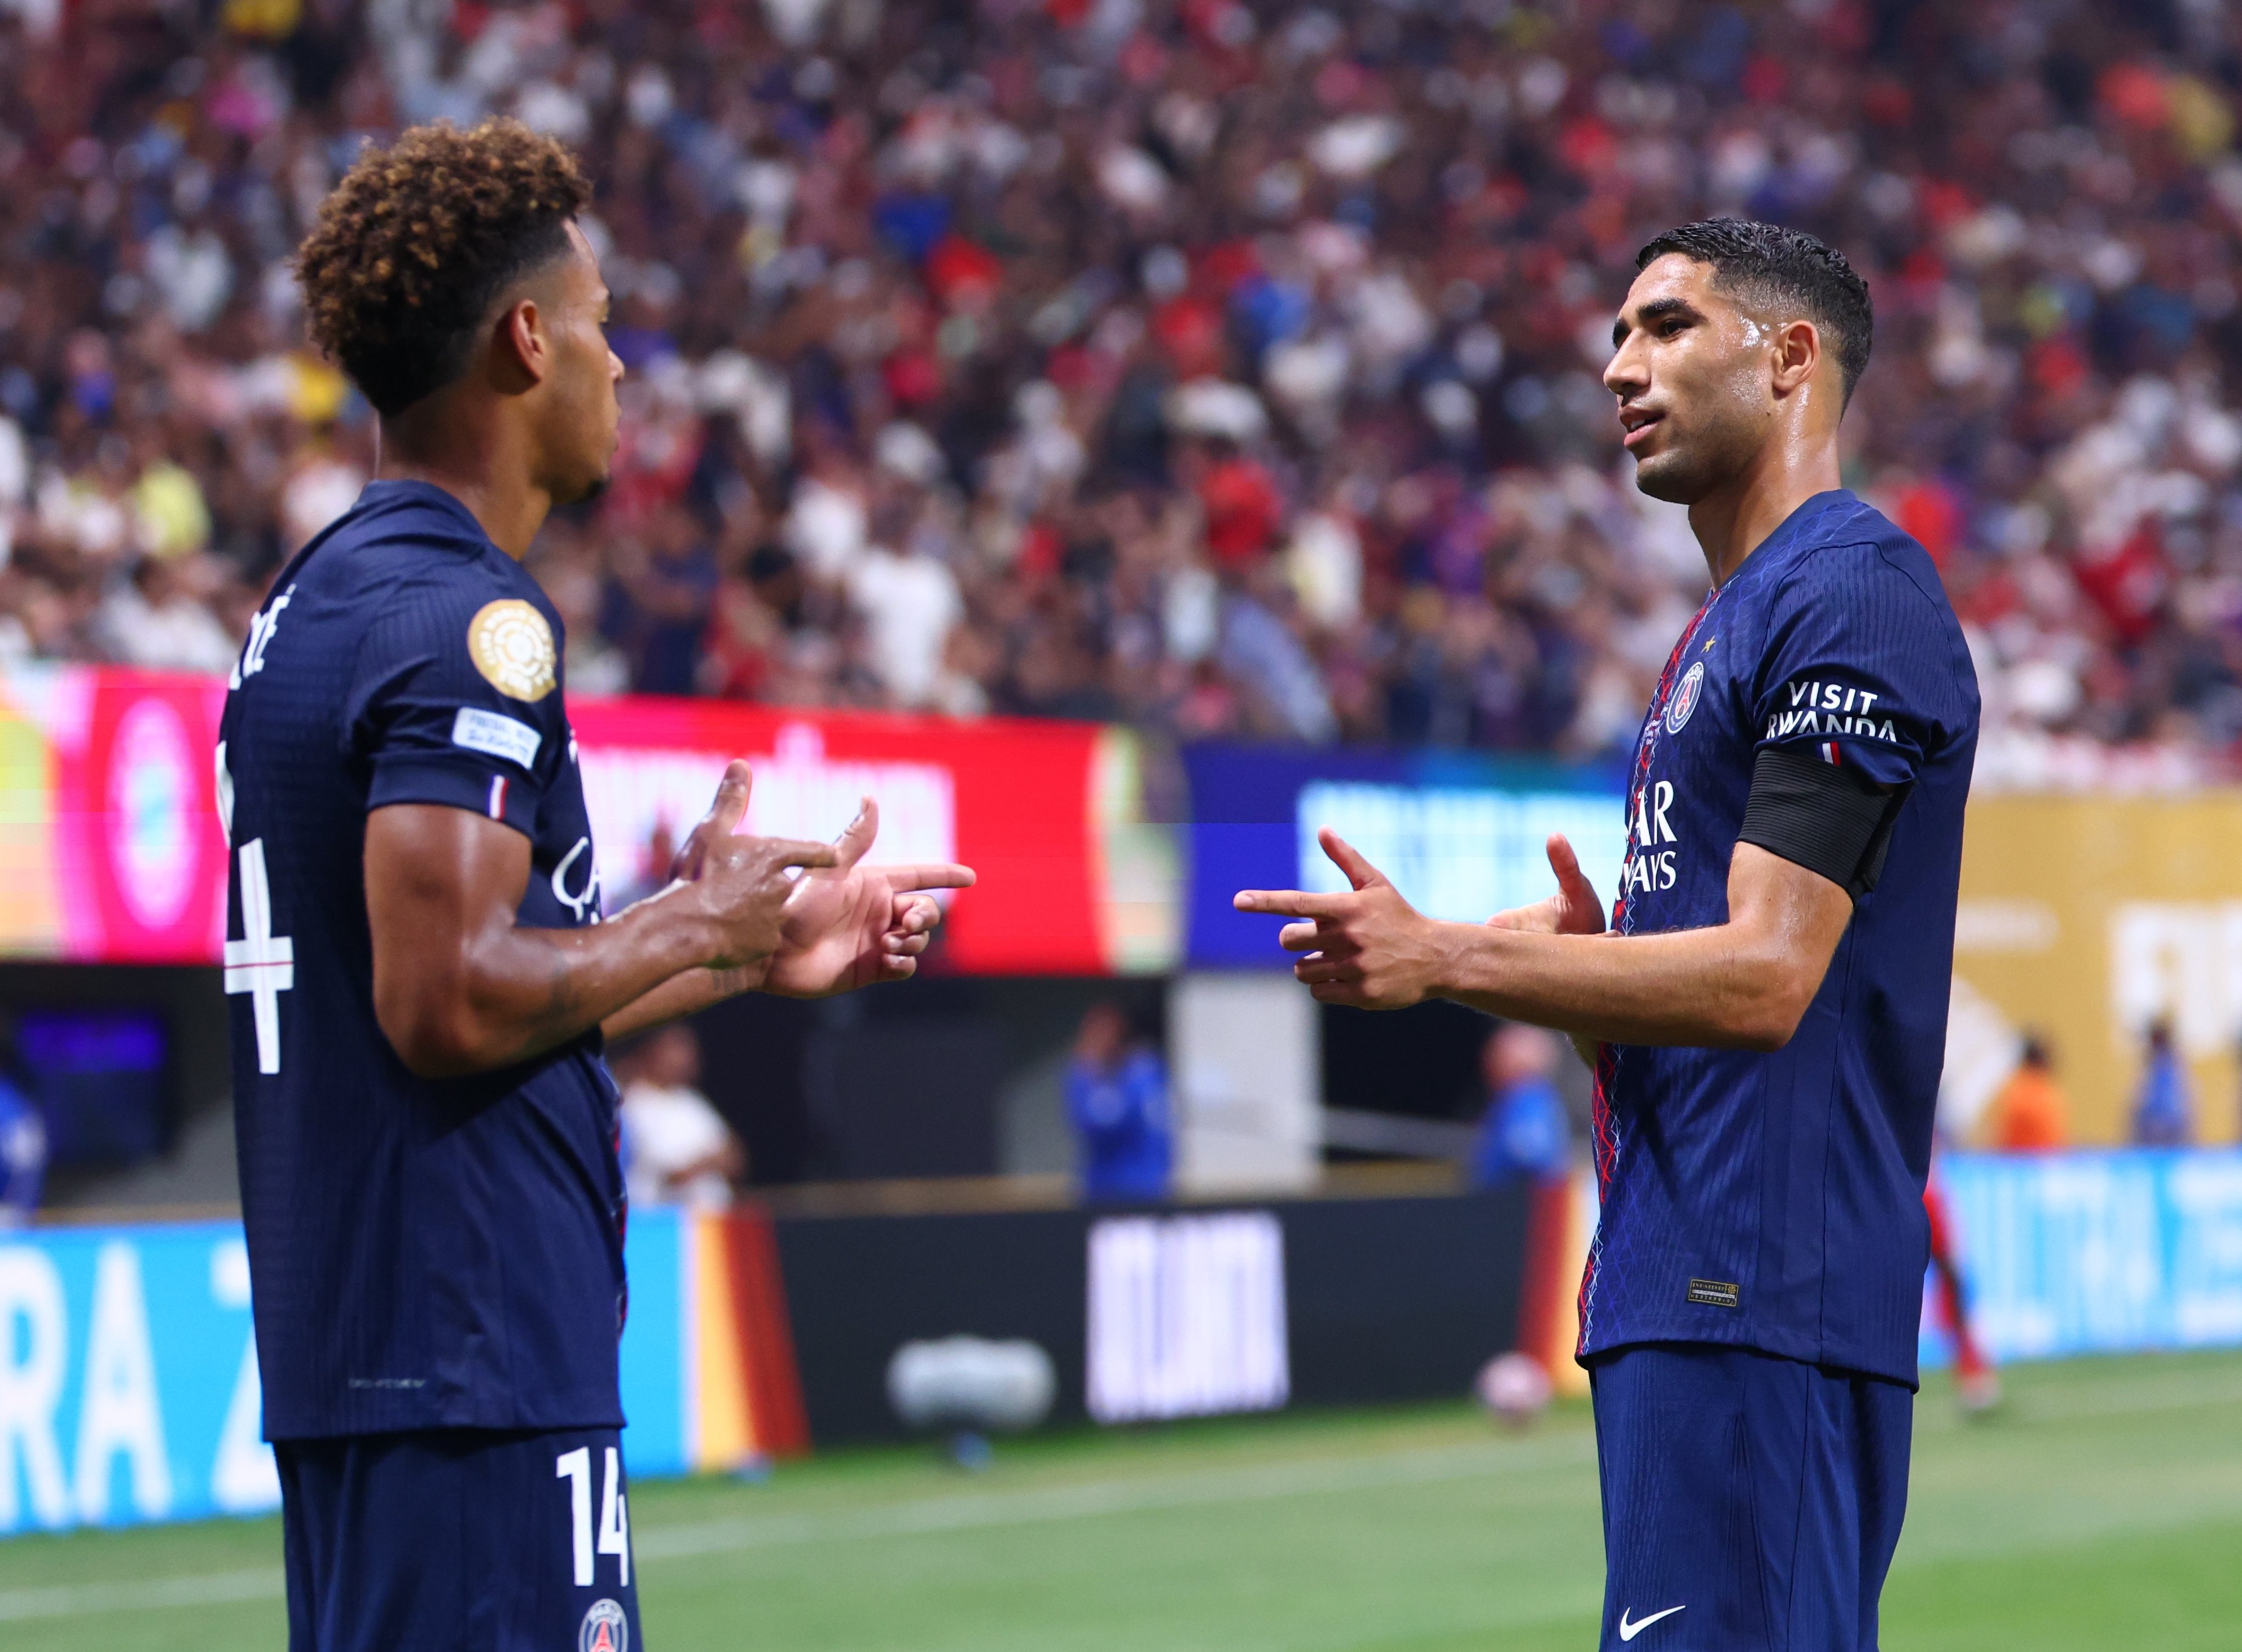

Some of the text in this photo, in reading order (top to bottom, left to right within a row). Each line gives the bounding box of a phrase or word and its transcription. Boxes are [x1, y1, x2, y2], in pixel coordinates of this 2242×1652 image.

[1684, 665, 1703, 684] PARIS
[1788, 681, 1878, 715] VISIT
[1766, 710, 1897, 742] RWANDA
[556, 1446, 630, 1588] 14
